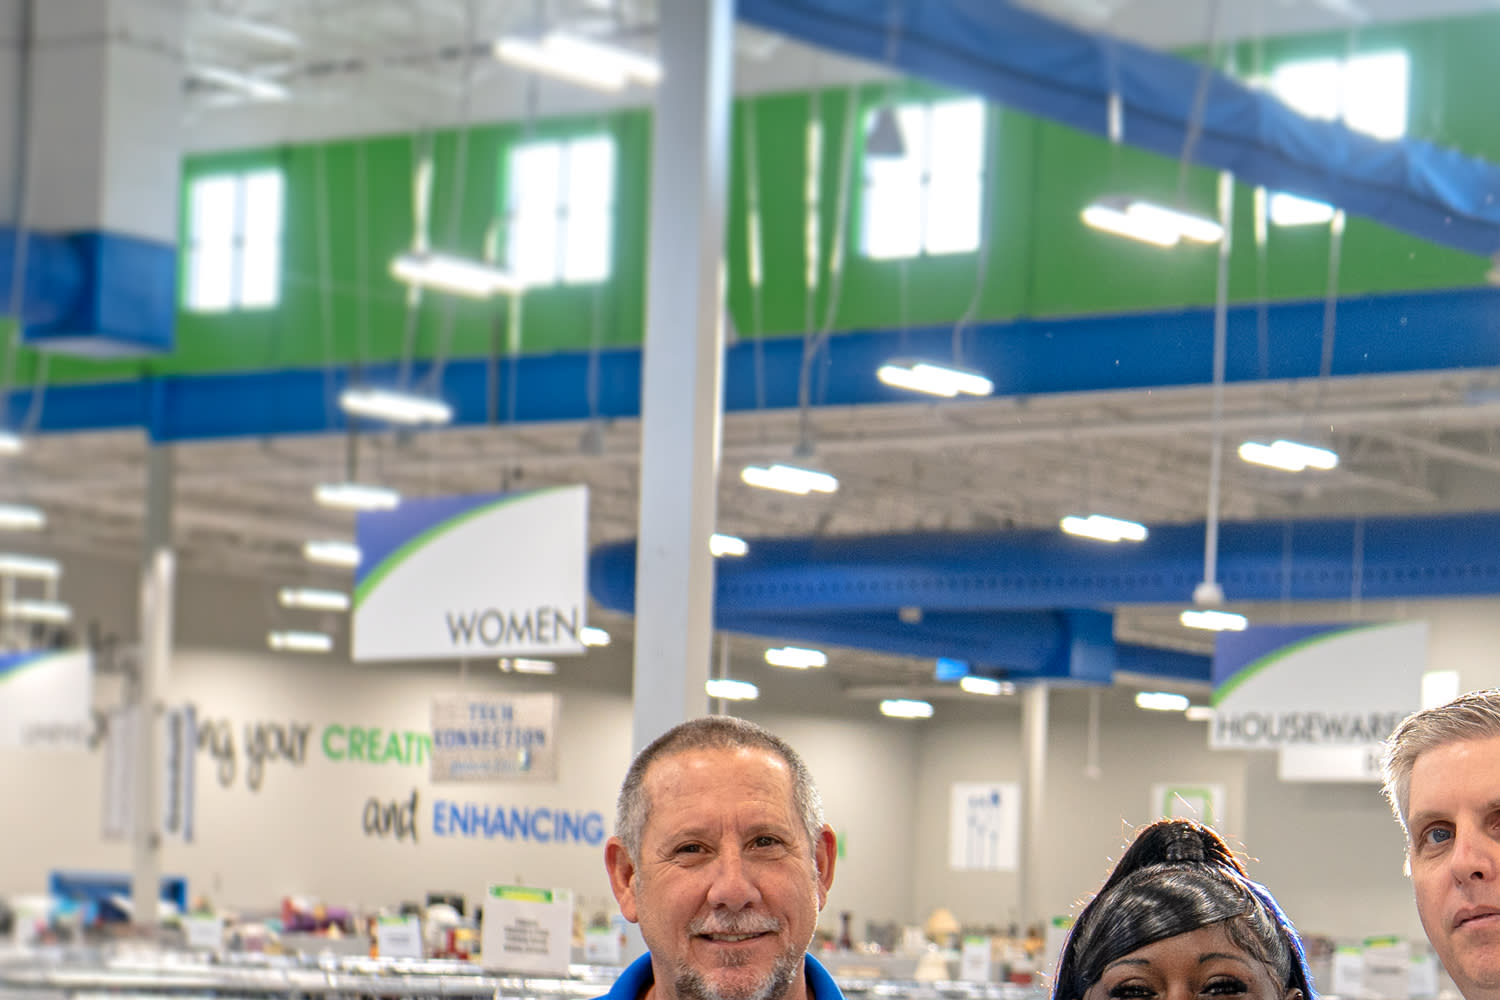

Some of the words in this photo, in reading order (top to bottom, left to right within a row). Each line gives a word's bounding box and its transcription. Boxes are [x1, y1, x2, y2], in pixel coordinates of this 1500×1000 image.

[446, 607, 578, 646] WOMEN
[1216, 712, 1402, 743] HOUSEWARE
[245, 720, 311, 791] your
[363, 787, 419, 843] and
[433, 800, 605, 845] ENHANCING
